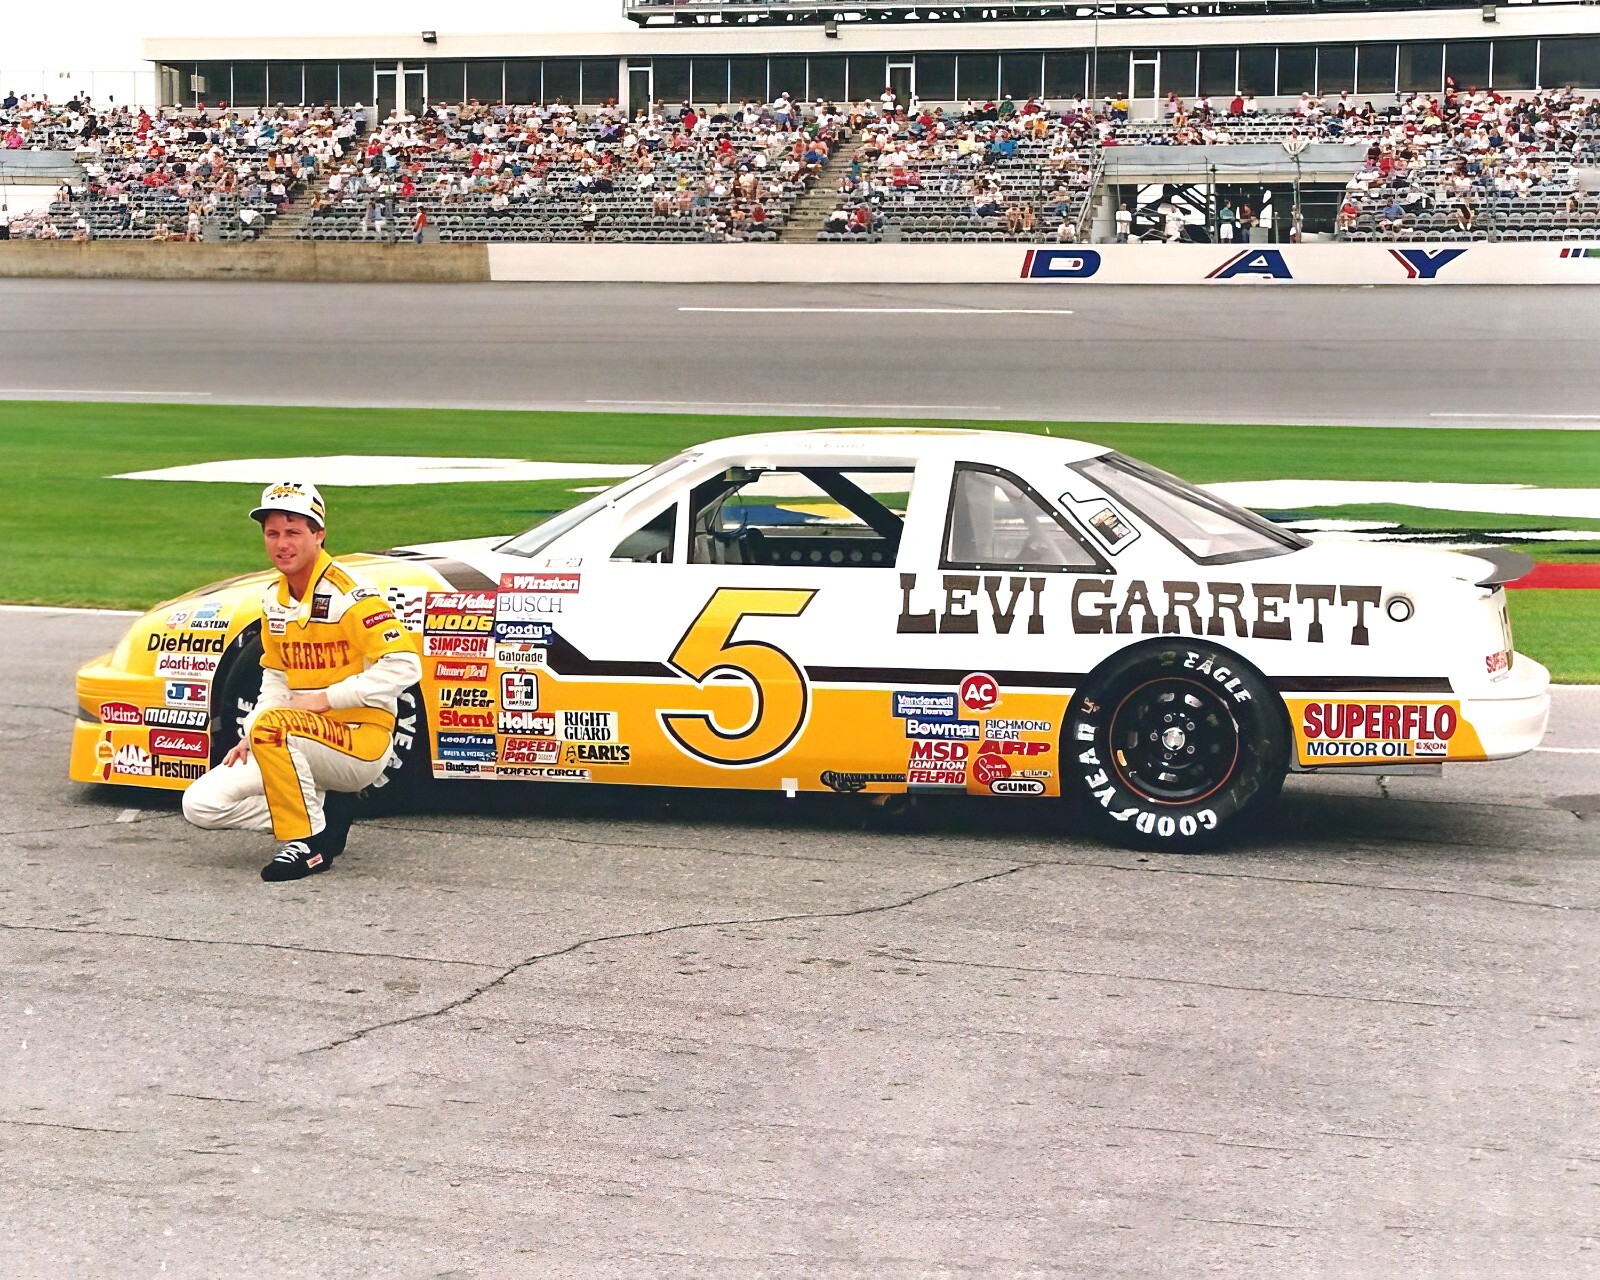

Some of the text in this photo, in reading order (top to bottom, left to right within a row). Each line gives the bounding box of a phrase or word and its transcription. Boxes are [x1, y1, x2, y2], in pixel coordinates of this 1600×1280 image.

[513, 575, 579, 590] Winston
[451, 593, 495, 610] Value
[498, 595, 563, 613] BUSCH
[896, 573, 1382, 646] LEVI GARRETT
[425, 614, 494, 631] MOOG
[496, 623, 552, 638] Goody's
[147, 632, 225, 653] DieHard
[429, 637, 489, 652] SIMPSON
[498, 650, 543, 663] Gatorade
[657, 586, 820, 768] 5
[1183, 651, 1252, 704] EAGLE
[167, 682, 207, 702] JE
[453, 687, 489, 699] Auto
[964, 683, 994, 702] AC
[102, 706, 140, 723] Heinz
[145, 708, 207, 727] MOROSO
[439, 709, 495, 728] Stant
[498, 710, 554, 735] Holley
[564, 711, 611, 727] RIGHT
[1303, 702, 1457, 741] SUPERFLO
[907, 719, 979, 737] Bowman
[985, 719, 1052, 731] RICHMOND
[564, 727, 611, 741] GUARD
[985, 730, 1019, 740] GEAR
[154, 735, 203, 752] Edelbrock
[507, 739, 557, 753] SPEED
[910, 741, 970, 761] MSD
[976, 740, 1052, 756] ARP
[1306, 742, 1412, 757] MOTOR OIL
[1415, 741, 1447, 751] EXXON
[504, 751, 538, 763] PRO
[577, 744, 631, 761] EARL'S
[151, 754, 207, 781] Prestone
[495, 766, 545, 777] PERFECT
[546, 768, 588, 778] CIRCLE
[909, 760, 966, 770] IGNITION
[996, 782, 1041, 792] GUNK
